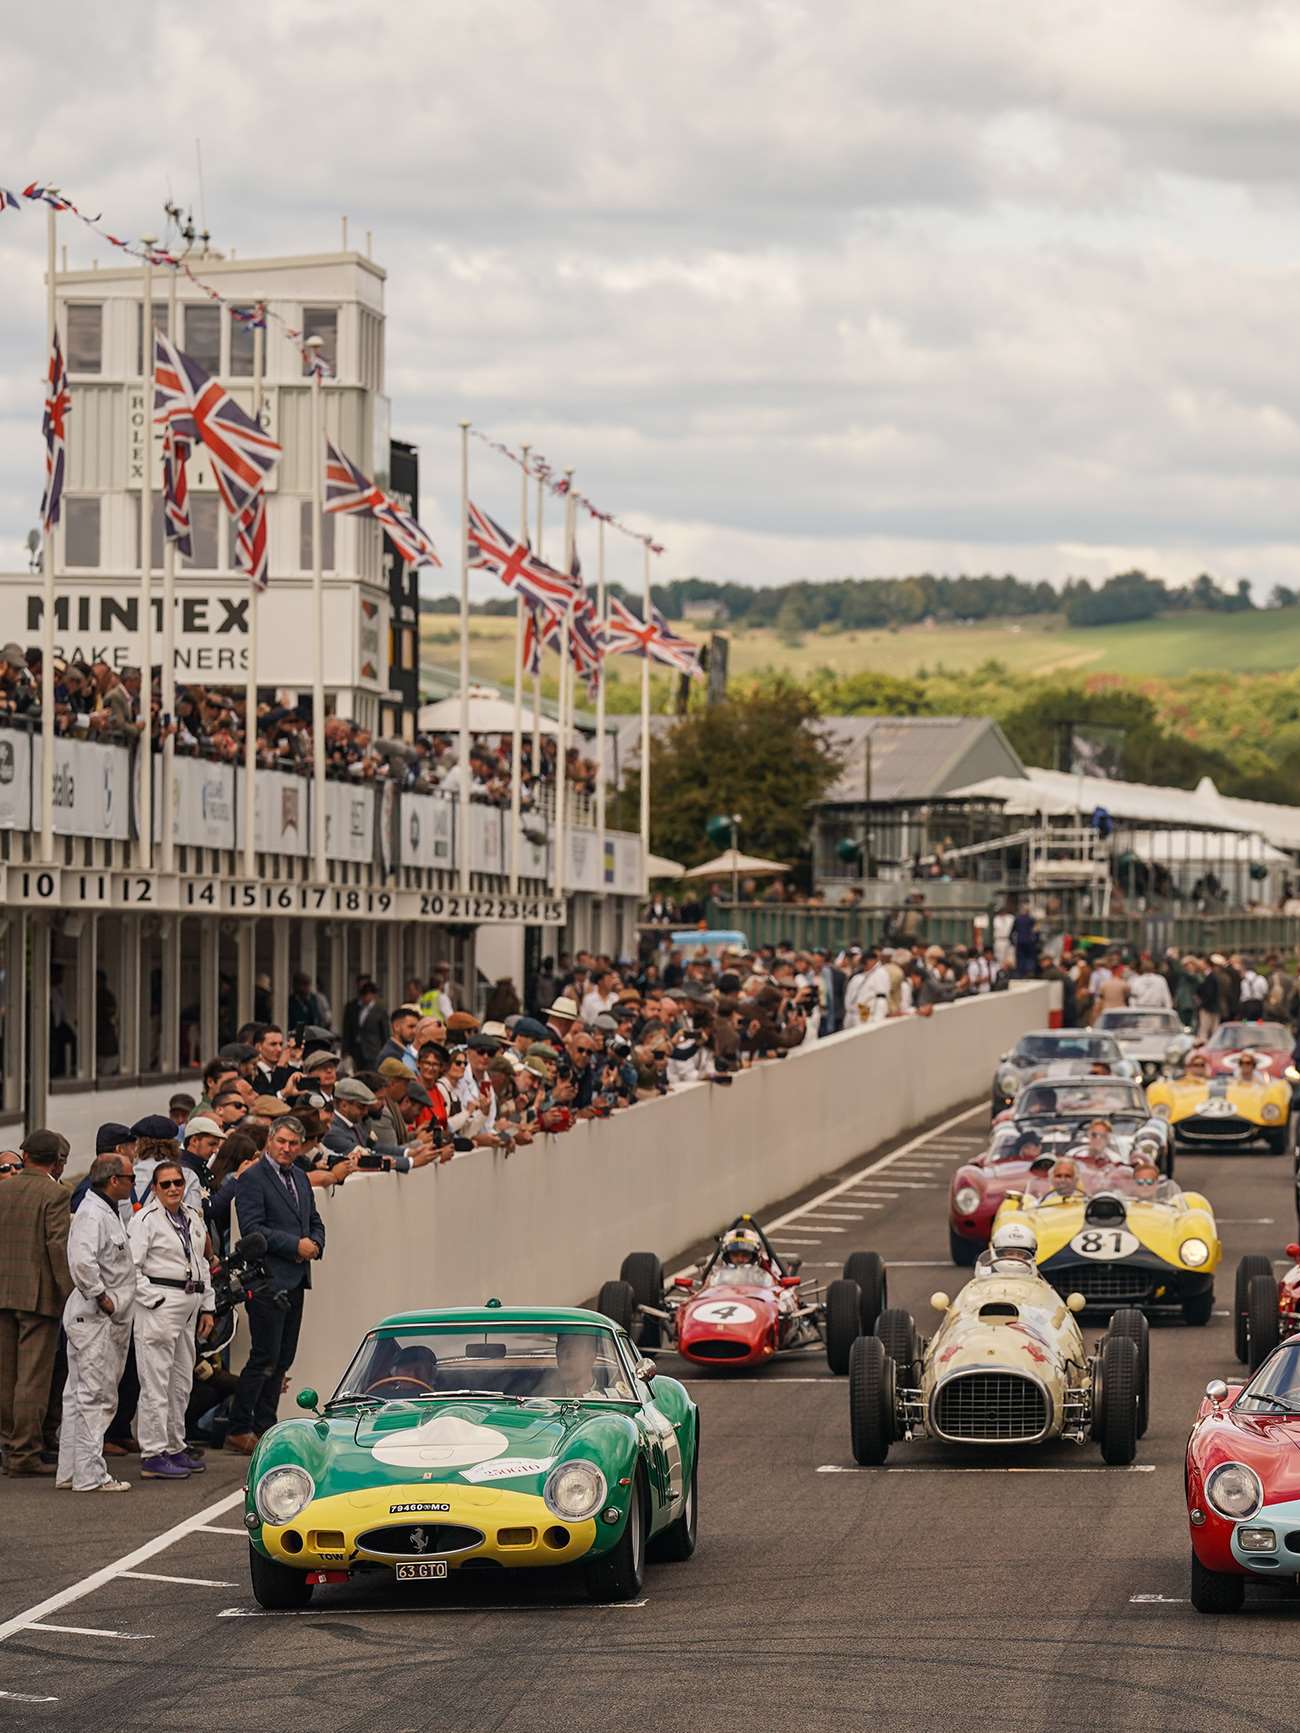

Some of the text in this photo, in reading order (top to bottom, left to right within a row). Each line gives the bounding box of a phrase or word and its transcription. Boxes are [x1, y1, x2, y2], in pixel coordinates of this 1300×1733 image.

[132, 396, 144, 478] ROLEX
[26, 595, 249, 633] MINTEX
[173, 647, 249, 670] NERS
[23, 872, 54, 898] 10
[79, 875, 104, 899] 11
[123, 878, 152, 902] 12
[187, 882, 214, 905] 14
[230, 885, 256, 907] 15
[265, 887, 292, 909] 16
[302, 888, 326, 910] 17
[335, 890, 360, 911] 18
[367, 893, 392, 913] 19
[421, 894, 444, 915] 20
[449, 898, 470, 917] 21
[474, 899, 494, 917] 22
[499, 901, 519, 919] 23
[1081, 1231, 1122, 1253] 81
[710, 1305, 739, 1320] 4
[318, 1552, 345, 1561] TOW
[399, 1563, 446, 1578] 63 GTO
